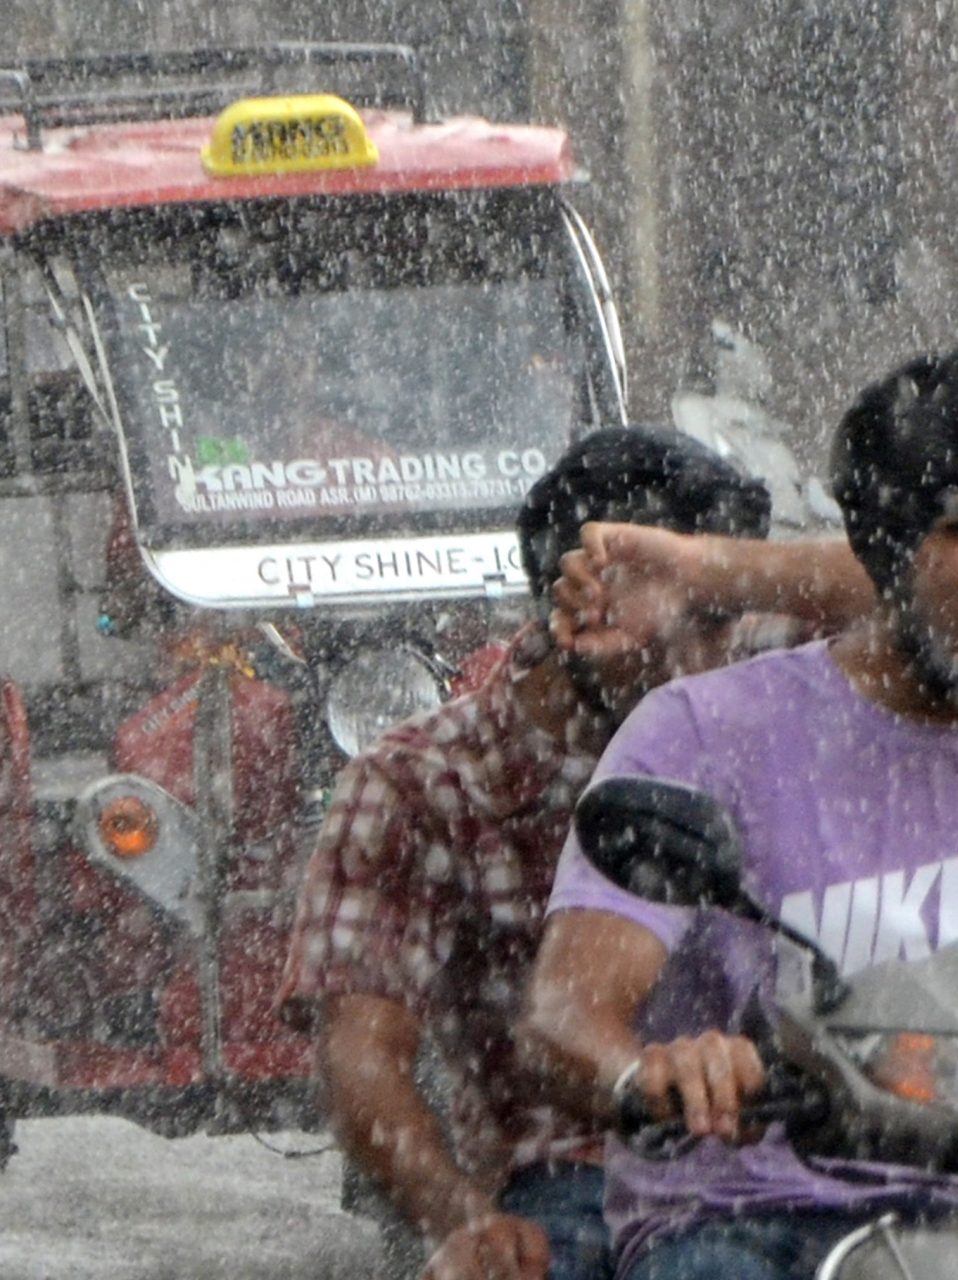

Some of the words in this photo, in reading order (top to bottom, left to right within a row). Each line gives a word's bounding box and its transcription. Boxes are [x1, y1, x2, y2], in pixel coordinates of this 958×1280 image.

[129, 283, 172, 371] CITY
[153, 379, 198, 495] SHIN
[190, 459, 327, 492] KANG
[328, 452, 487, 487] TRADING
[276, 486, 317, 508] ROAD
[257, 553, 341, 585] CITY
